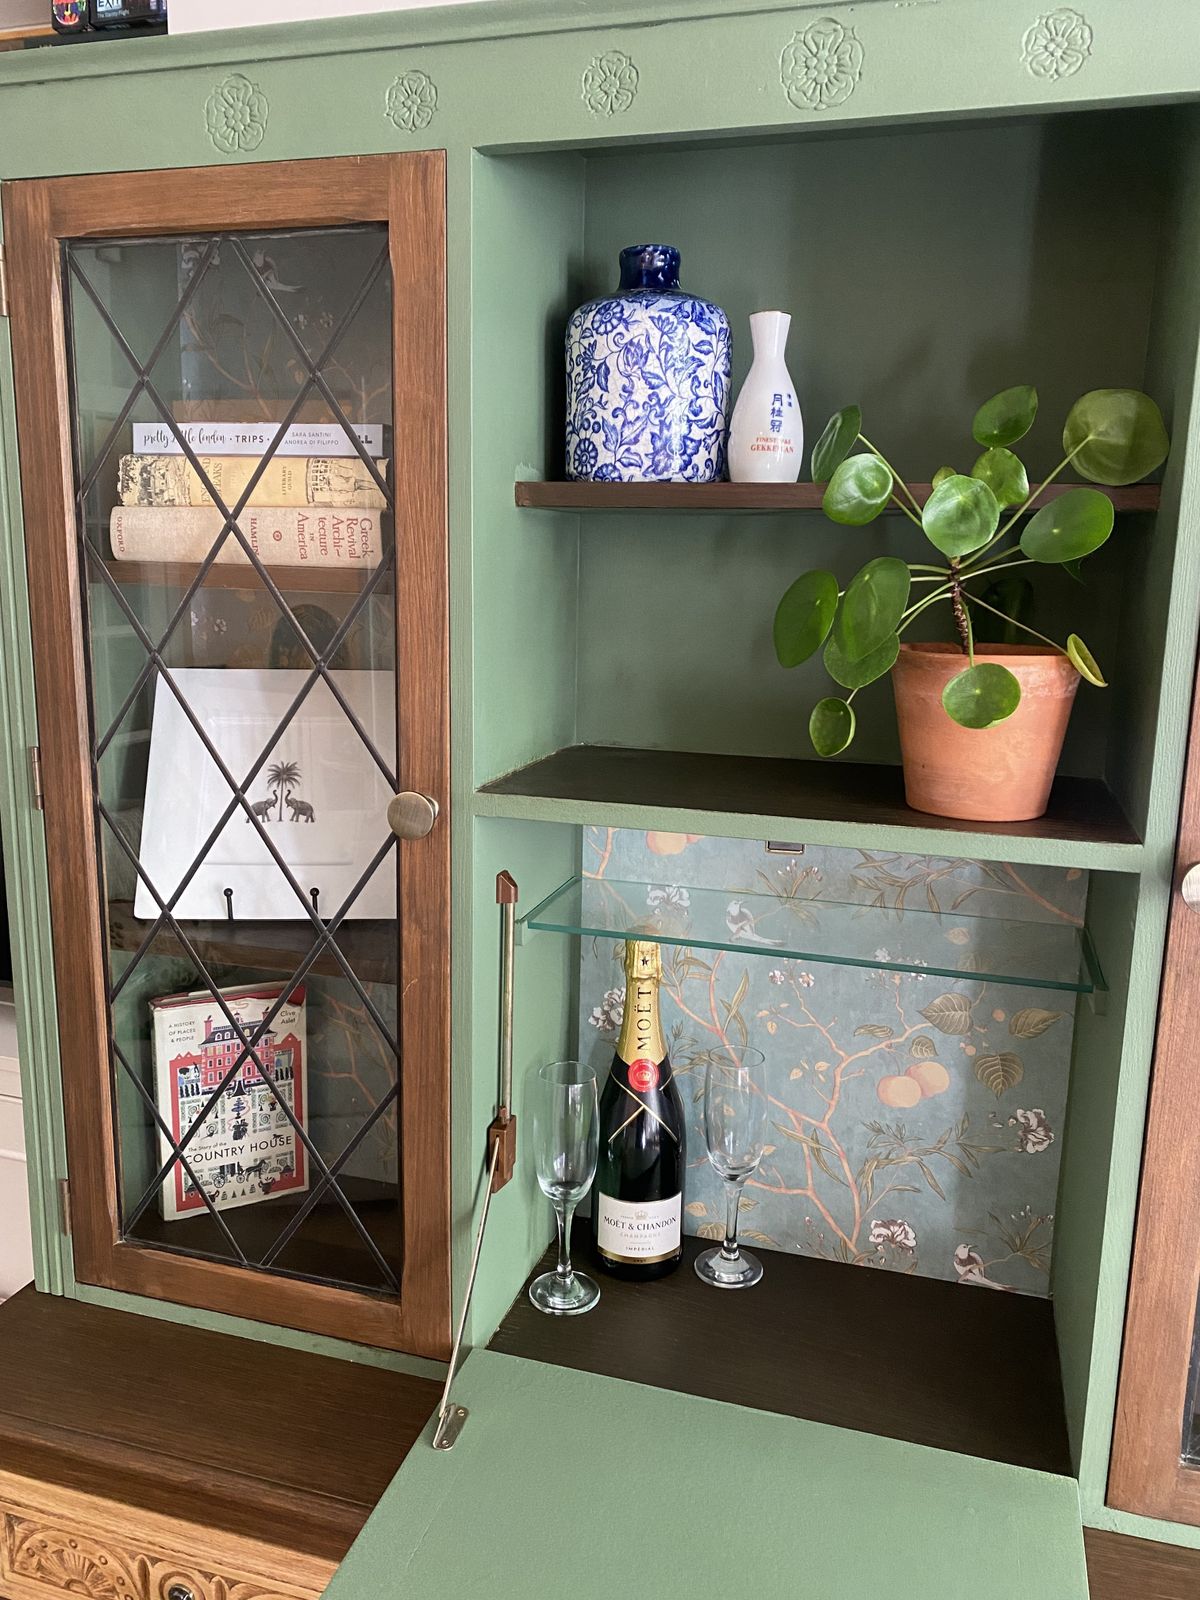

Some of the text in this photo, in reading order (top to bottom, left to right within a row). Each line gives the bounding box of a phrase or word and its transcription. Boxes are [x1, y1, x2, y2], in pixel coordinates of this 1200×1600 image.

[144, 428, 264, 448] pretty ttle london TRIPS
[750, 443, 794, 453] GEKKEAN
[201, 457, 211, 503] ENND
[213, 463, 223, 498] PEAKS
[117, 516, 125, 552] OXFORD
[251, 517, 259, 556] HAMLIN
[297, 512, 310, 560] America
[309, 533, 315, 541] IN
[318, 517, 328, 556] tecture
[346, 518, 361, 559] Revival
[360, 517, 374, 558] Greek
[634, 987, 651, 1050] MOËT
[186, 1136, 292, 1165] COUNTRY HOUSE
[637, 1216, 677, 1230] CHANDON
